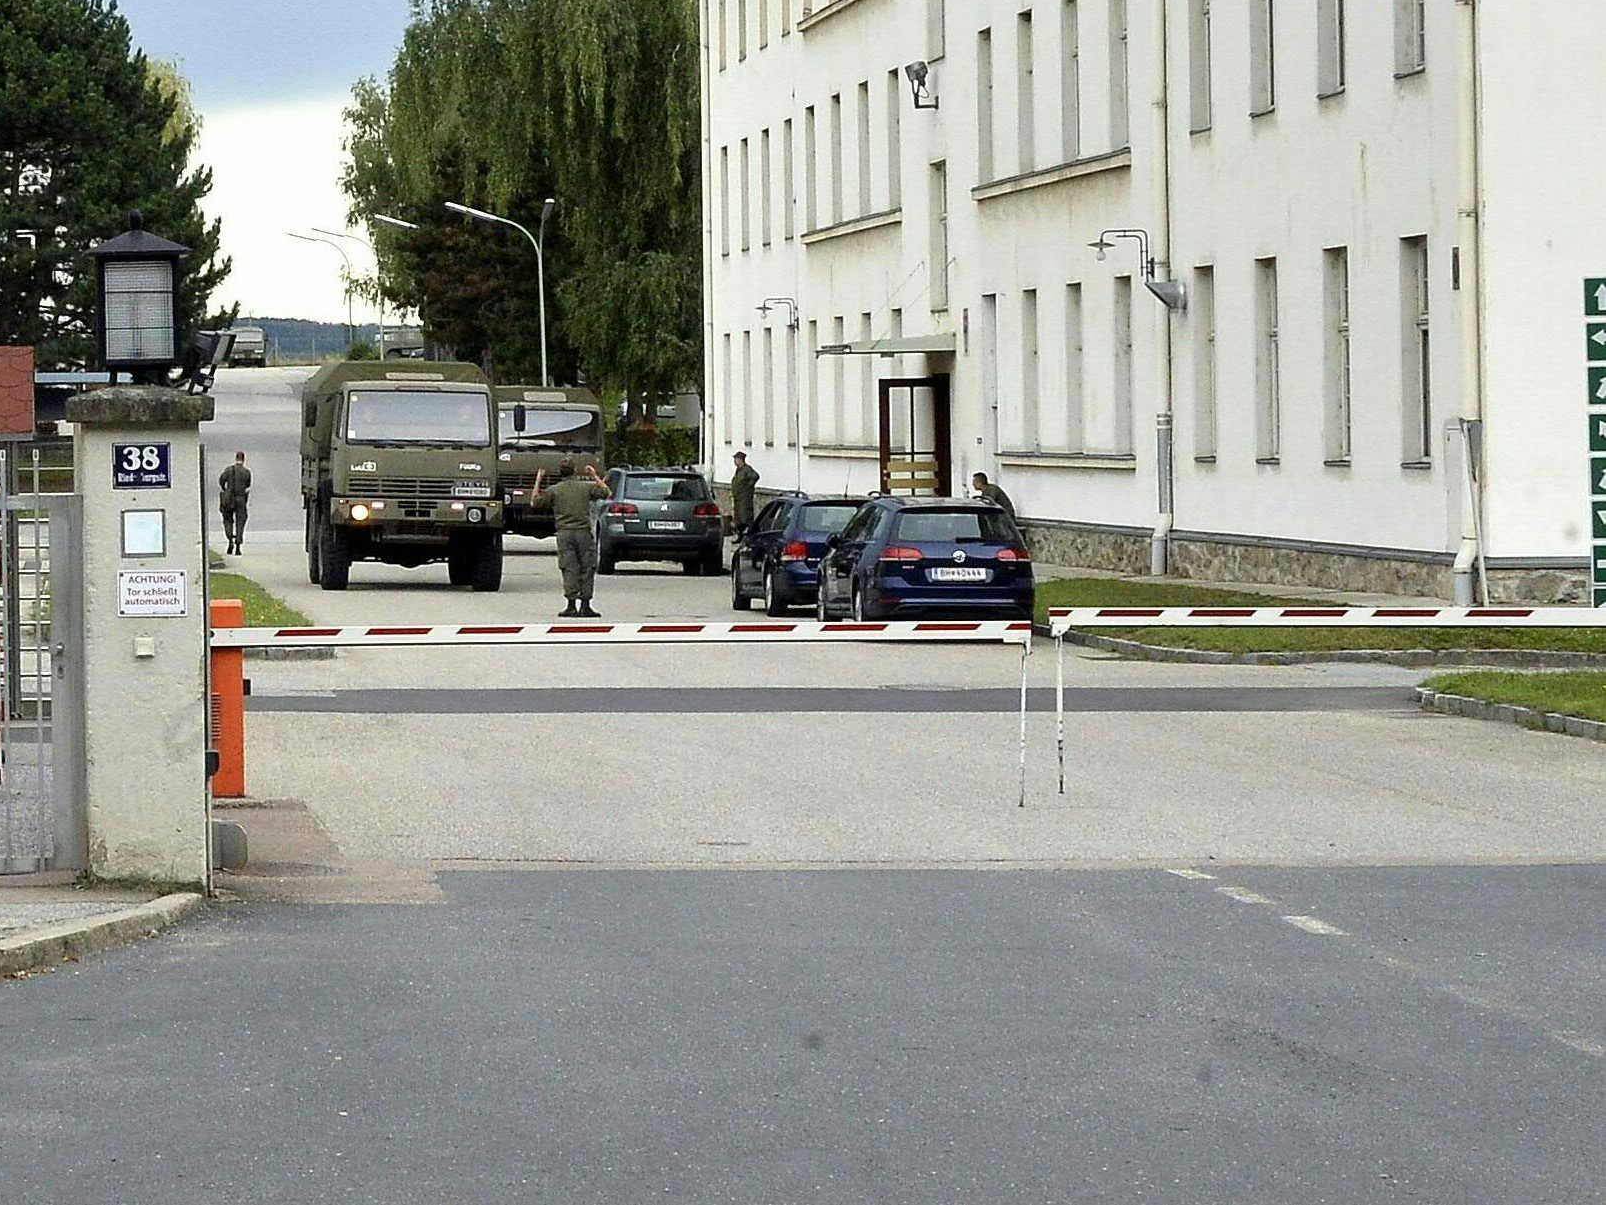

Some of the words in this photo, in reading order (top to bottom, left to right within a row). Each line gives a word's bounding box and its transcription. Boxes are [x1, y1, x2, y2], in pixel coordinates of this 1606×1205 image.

[123, 446, 160, 471] 38
[129, 575, 176, 583] ACHTUNG!
[127, 588, 141, 596] Tor
[143, 588, 178, 596] schließt
